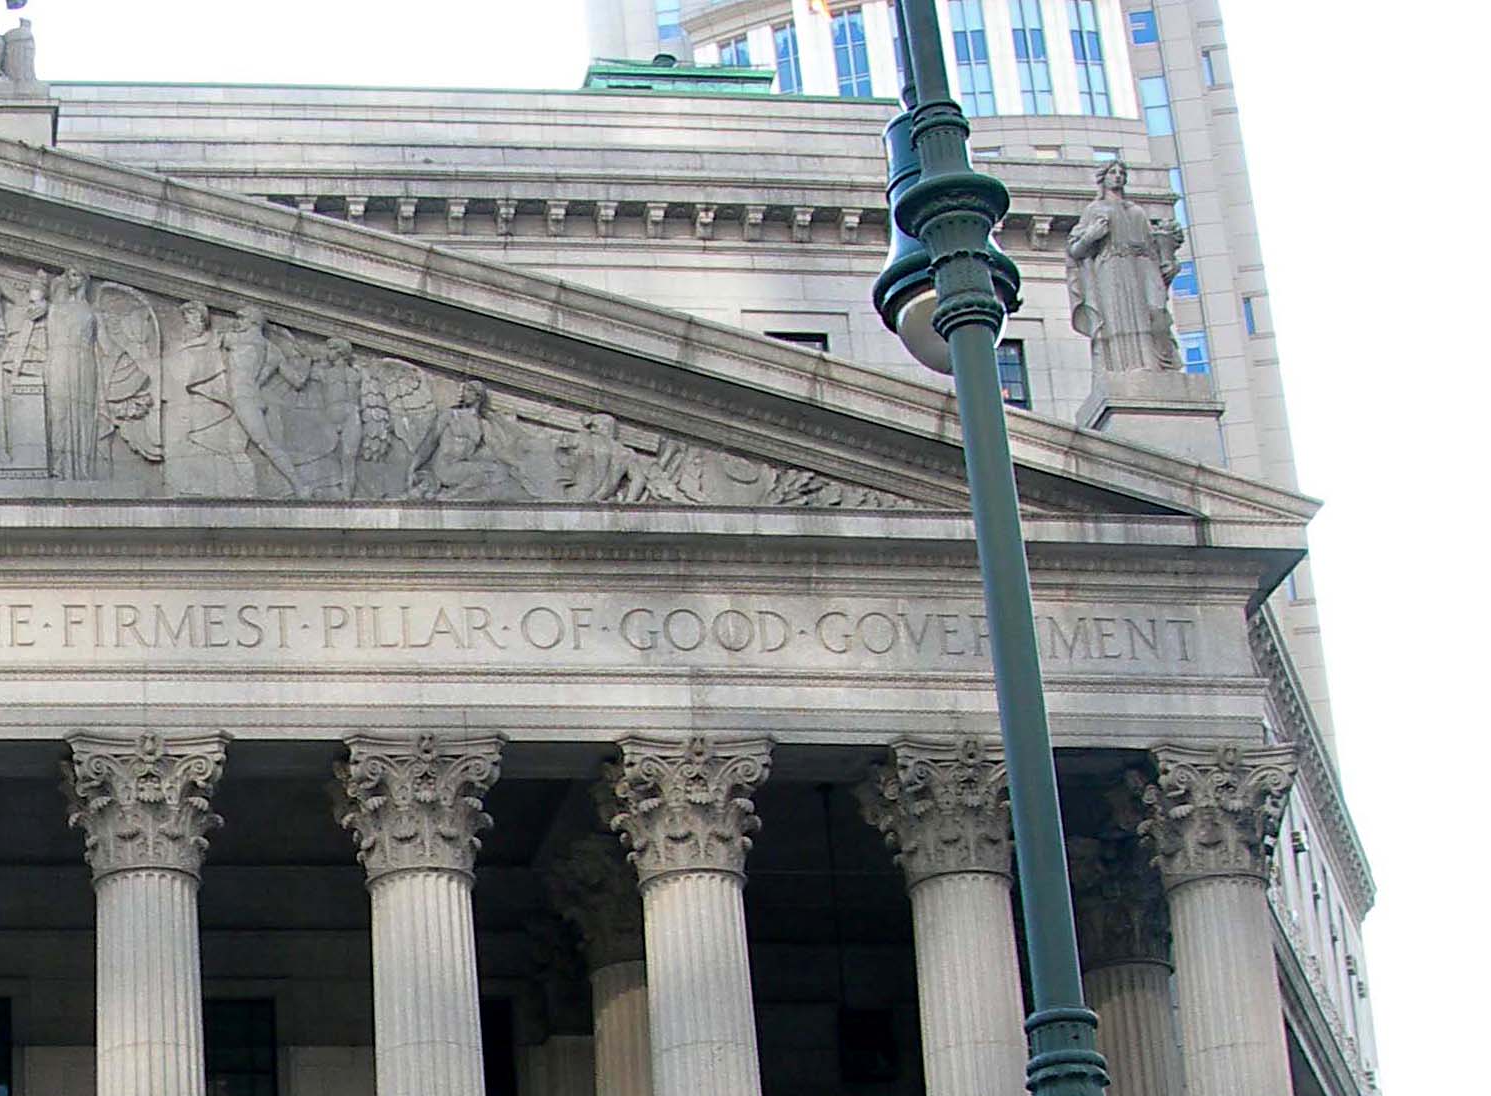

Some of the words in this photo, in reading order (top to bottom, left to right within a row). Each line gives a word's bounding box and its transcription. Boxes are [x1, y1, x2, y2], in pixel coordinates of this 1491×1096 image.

[61, 603, 297, 649] FIRMEST
[321, 605, 507, 650] PILLAR
[520, 606, 593, 651] OF
[619, 607, 789, 653] GOOD
[814, 610, 1195, 662] GOVEMENT
